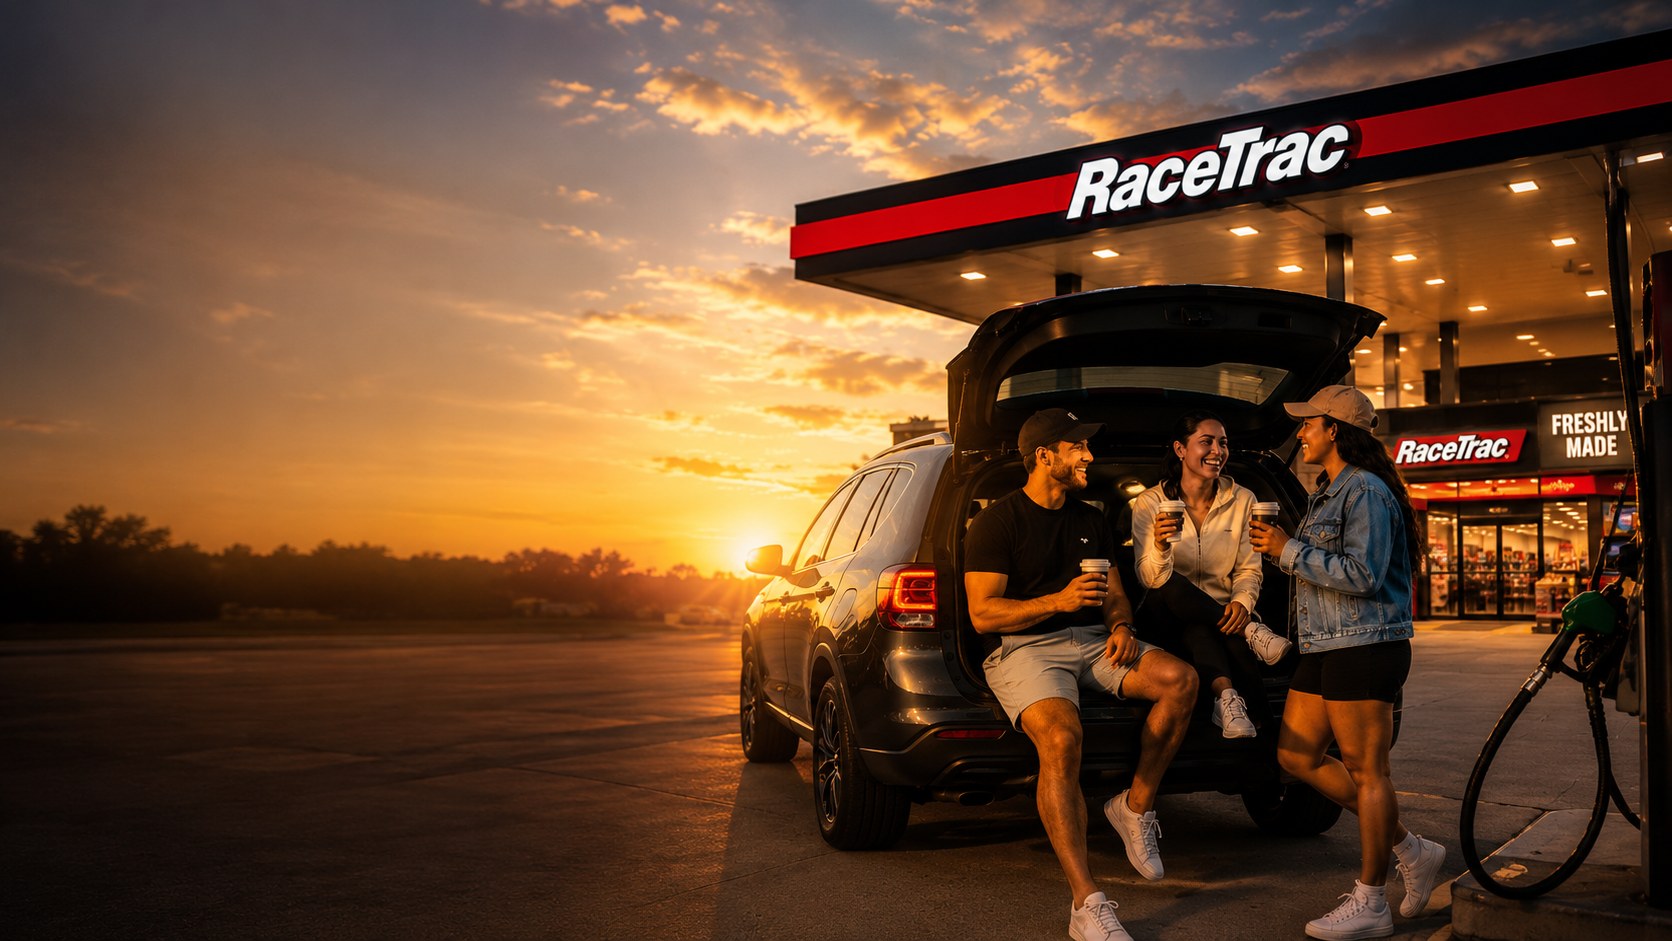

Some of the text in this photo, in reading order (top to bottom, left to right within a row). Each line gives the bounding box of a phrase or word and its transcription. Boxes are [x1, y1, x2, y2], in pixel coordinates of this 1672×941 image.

[1066, 124, 1349, 220] RaceTrac
[1552, 410, 1628, 435] FRESHLY
[1395, 434, 1508, 464] RaceTrac
[1566, 434, 1618, 459] MADE
